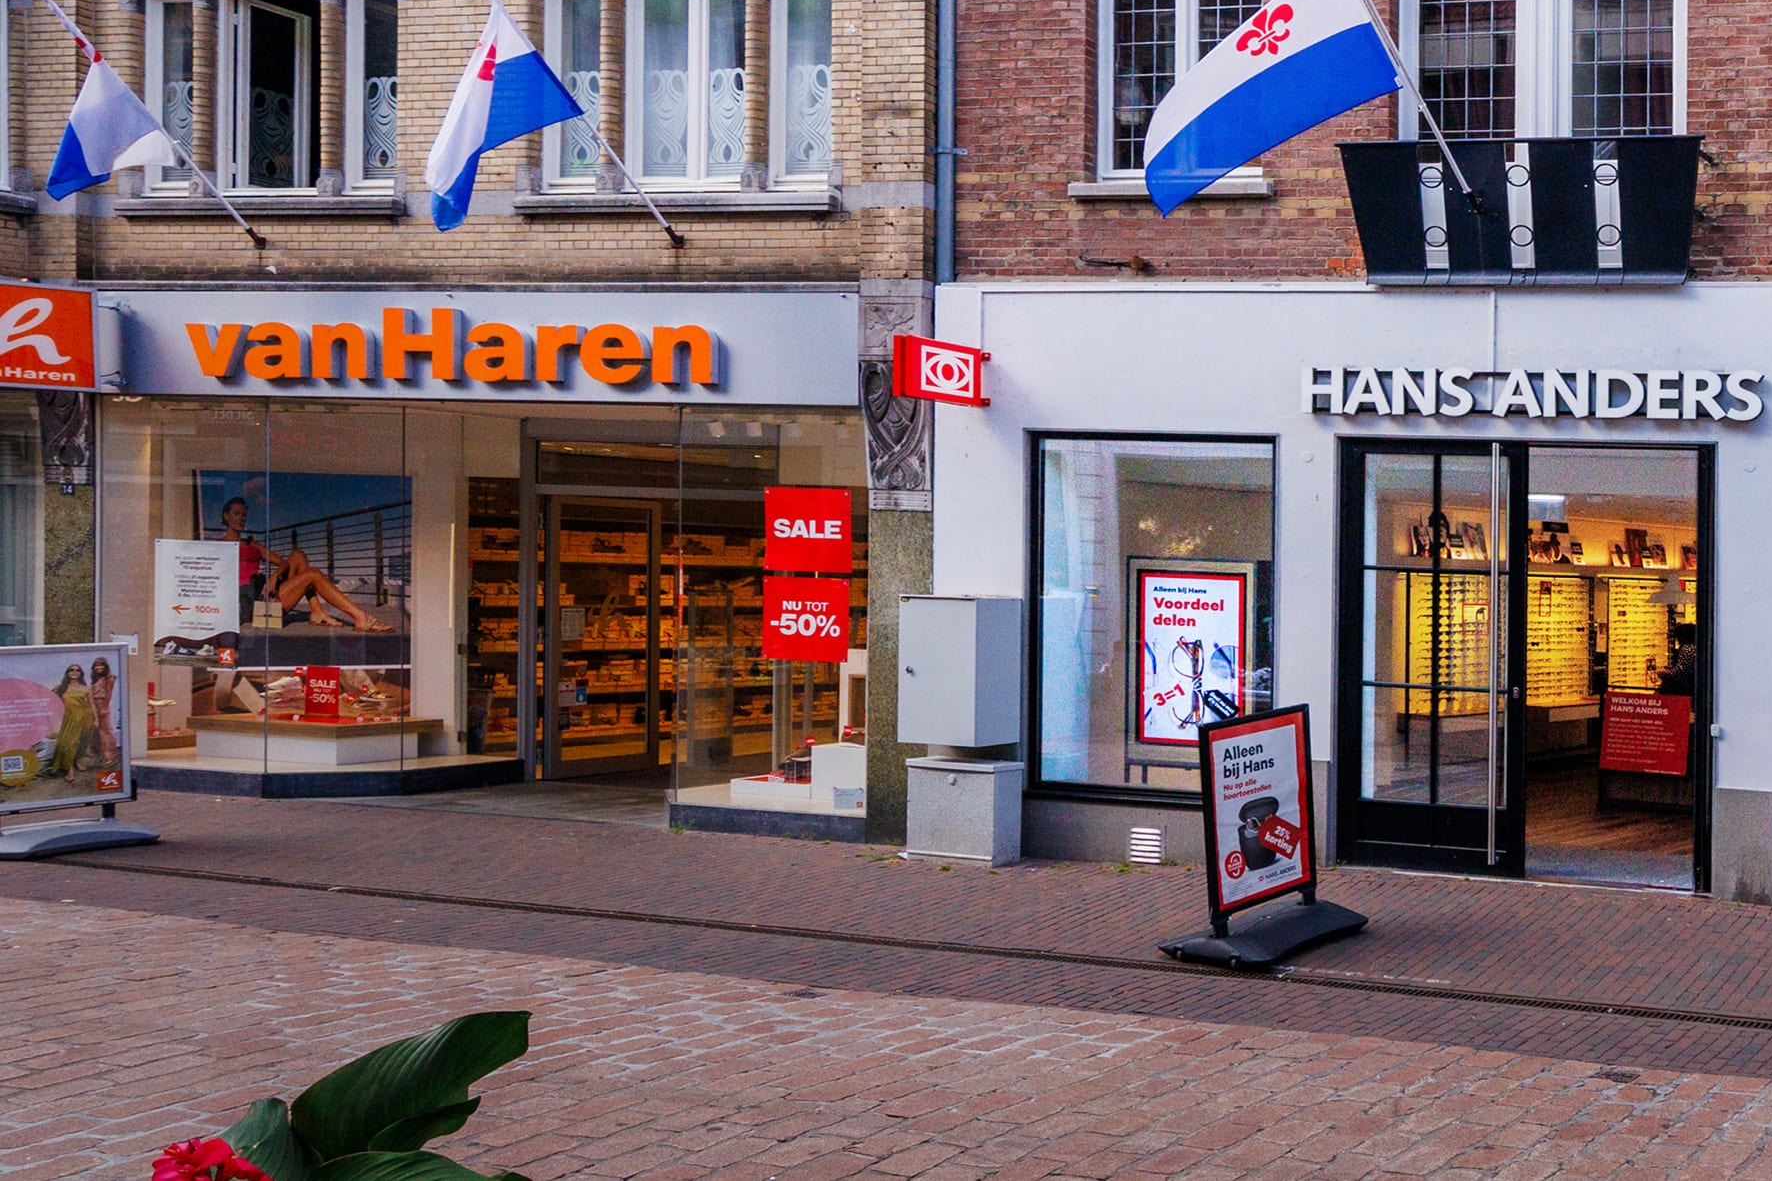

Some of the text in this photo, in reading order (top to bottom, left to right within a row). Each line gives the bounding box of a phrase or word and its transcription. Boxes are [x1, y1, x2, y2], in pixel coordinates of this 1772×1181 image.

[185, 307, 720, 385] vanHaren
[1302, 366, 1766, 422] HANS ANDERS
[773, 518, 842, 540] SALE
[782, 600, 829, 612] NU TOT
[1153, 597, 1225, 611] Voordeel
[770, 613, 841, 637] -50%
[1153, 614, 1196, 627] delen
[309, 678, 337, 689] SALE
[309, 693, 336, 704] -50%
[1153, 683, 1185, 706] 3=1
[1611, 697, 1662, 707] WELKOM BIJ
[1222, 743, 1264, 762] Alleen
[1223, 756, 1275, 779] bij Hans
[1223, 778, 1257, 792] Nu op alle
[1223, 784, 1272, 801] hoortoestellen
[1273, 825, 1291, 841] 25%
[1264, 831, 1293, 854] korting
